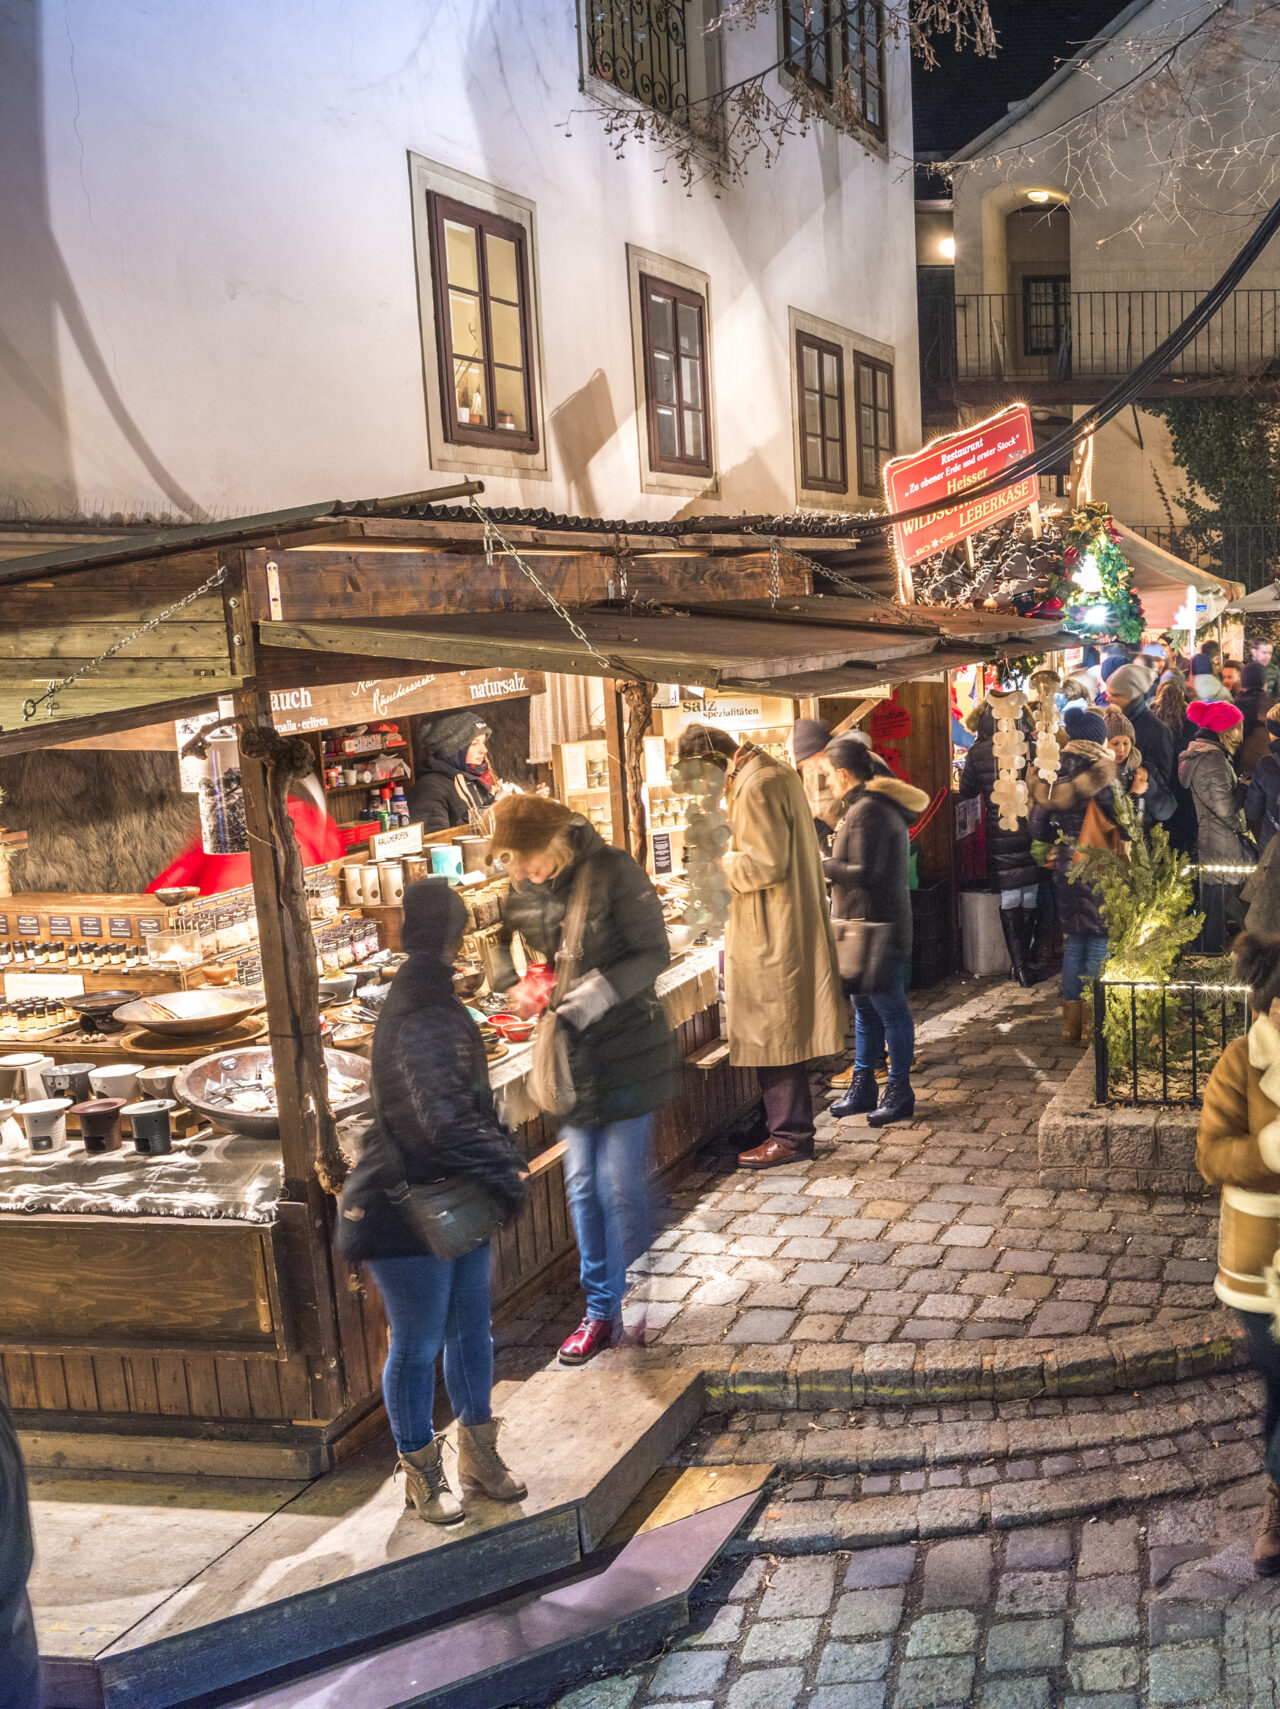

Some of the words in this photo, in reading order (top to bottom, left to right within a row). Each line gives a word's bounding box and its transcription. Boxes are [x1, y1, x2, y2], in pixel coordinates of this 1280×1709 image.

[940, 438, 984, 466] Restaurant
[920, 472, 945, 488] ebener
[945, 462, 962, 477] Erde
[962, 454, 976, 468] und
[976, 447, 997, 461] erster
[946, 466, 989, 495] Heisser
[959, 480, 1030, 529] LEBERKÄSE
[270, 688, 312, 712] auch
[470, 672, 528, 700] natursalz
[682, 695, 717, 713] salz
[702, 708, 759, 719] spezialitäten
[274, 720, 297, 732] malia
[302, 716, 328, 730] eritrea
